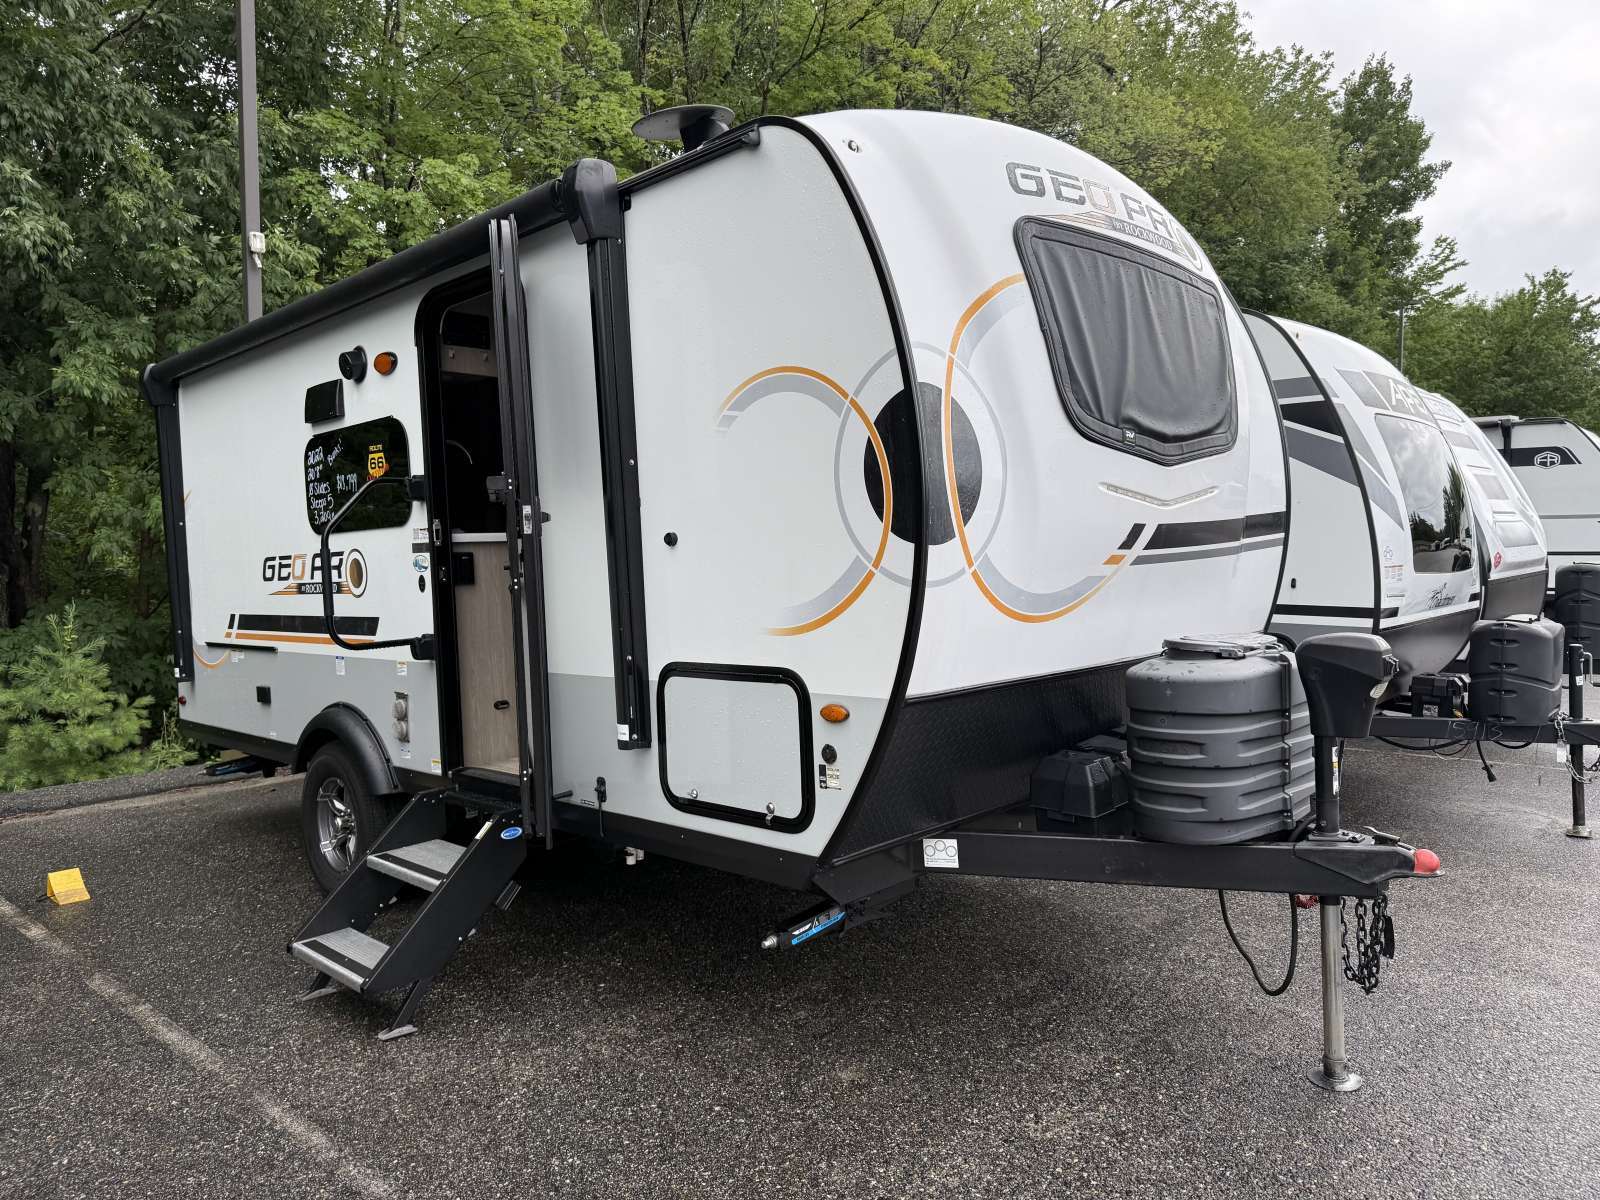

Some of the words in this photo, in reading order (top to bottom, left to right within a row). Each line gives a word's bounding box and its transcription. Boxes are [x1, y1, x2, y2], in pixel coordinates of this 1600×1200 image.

[1006, 161, 1117, 214] GEO
[1120, 192, 1203, 271] PRO
[370, 456, 384, 470] 66
[262, 553, 307, 582] GEO
